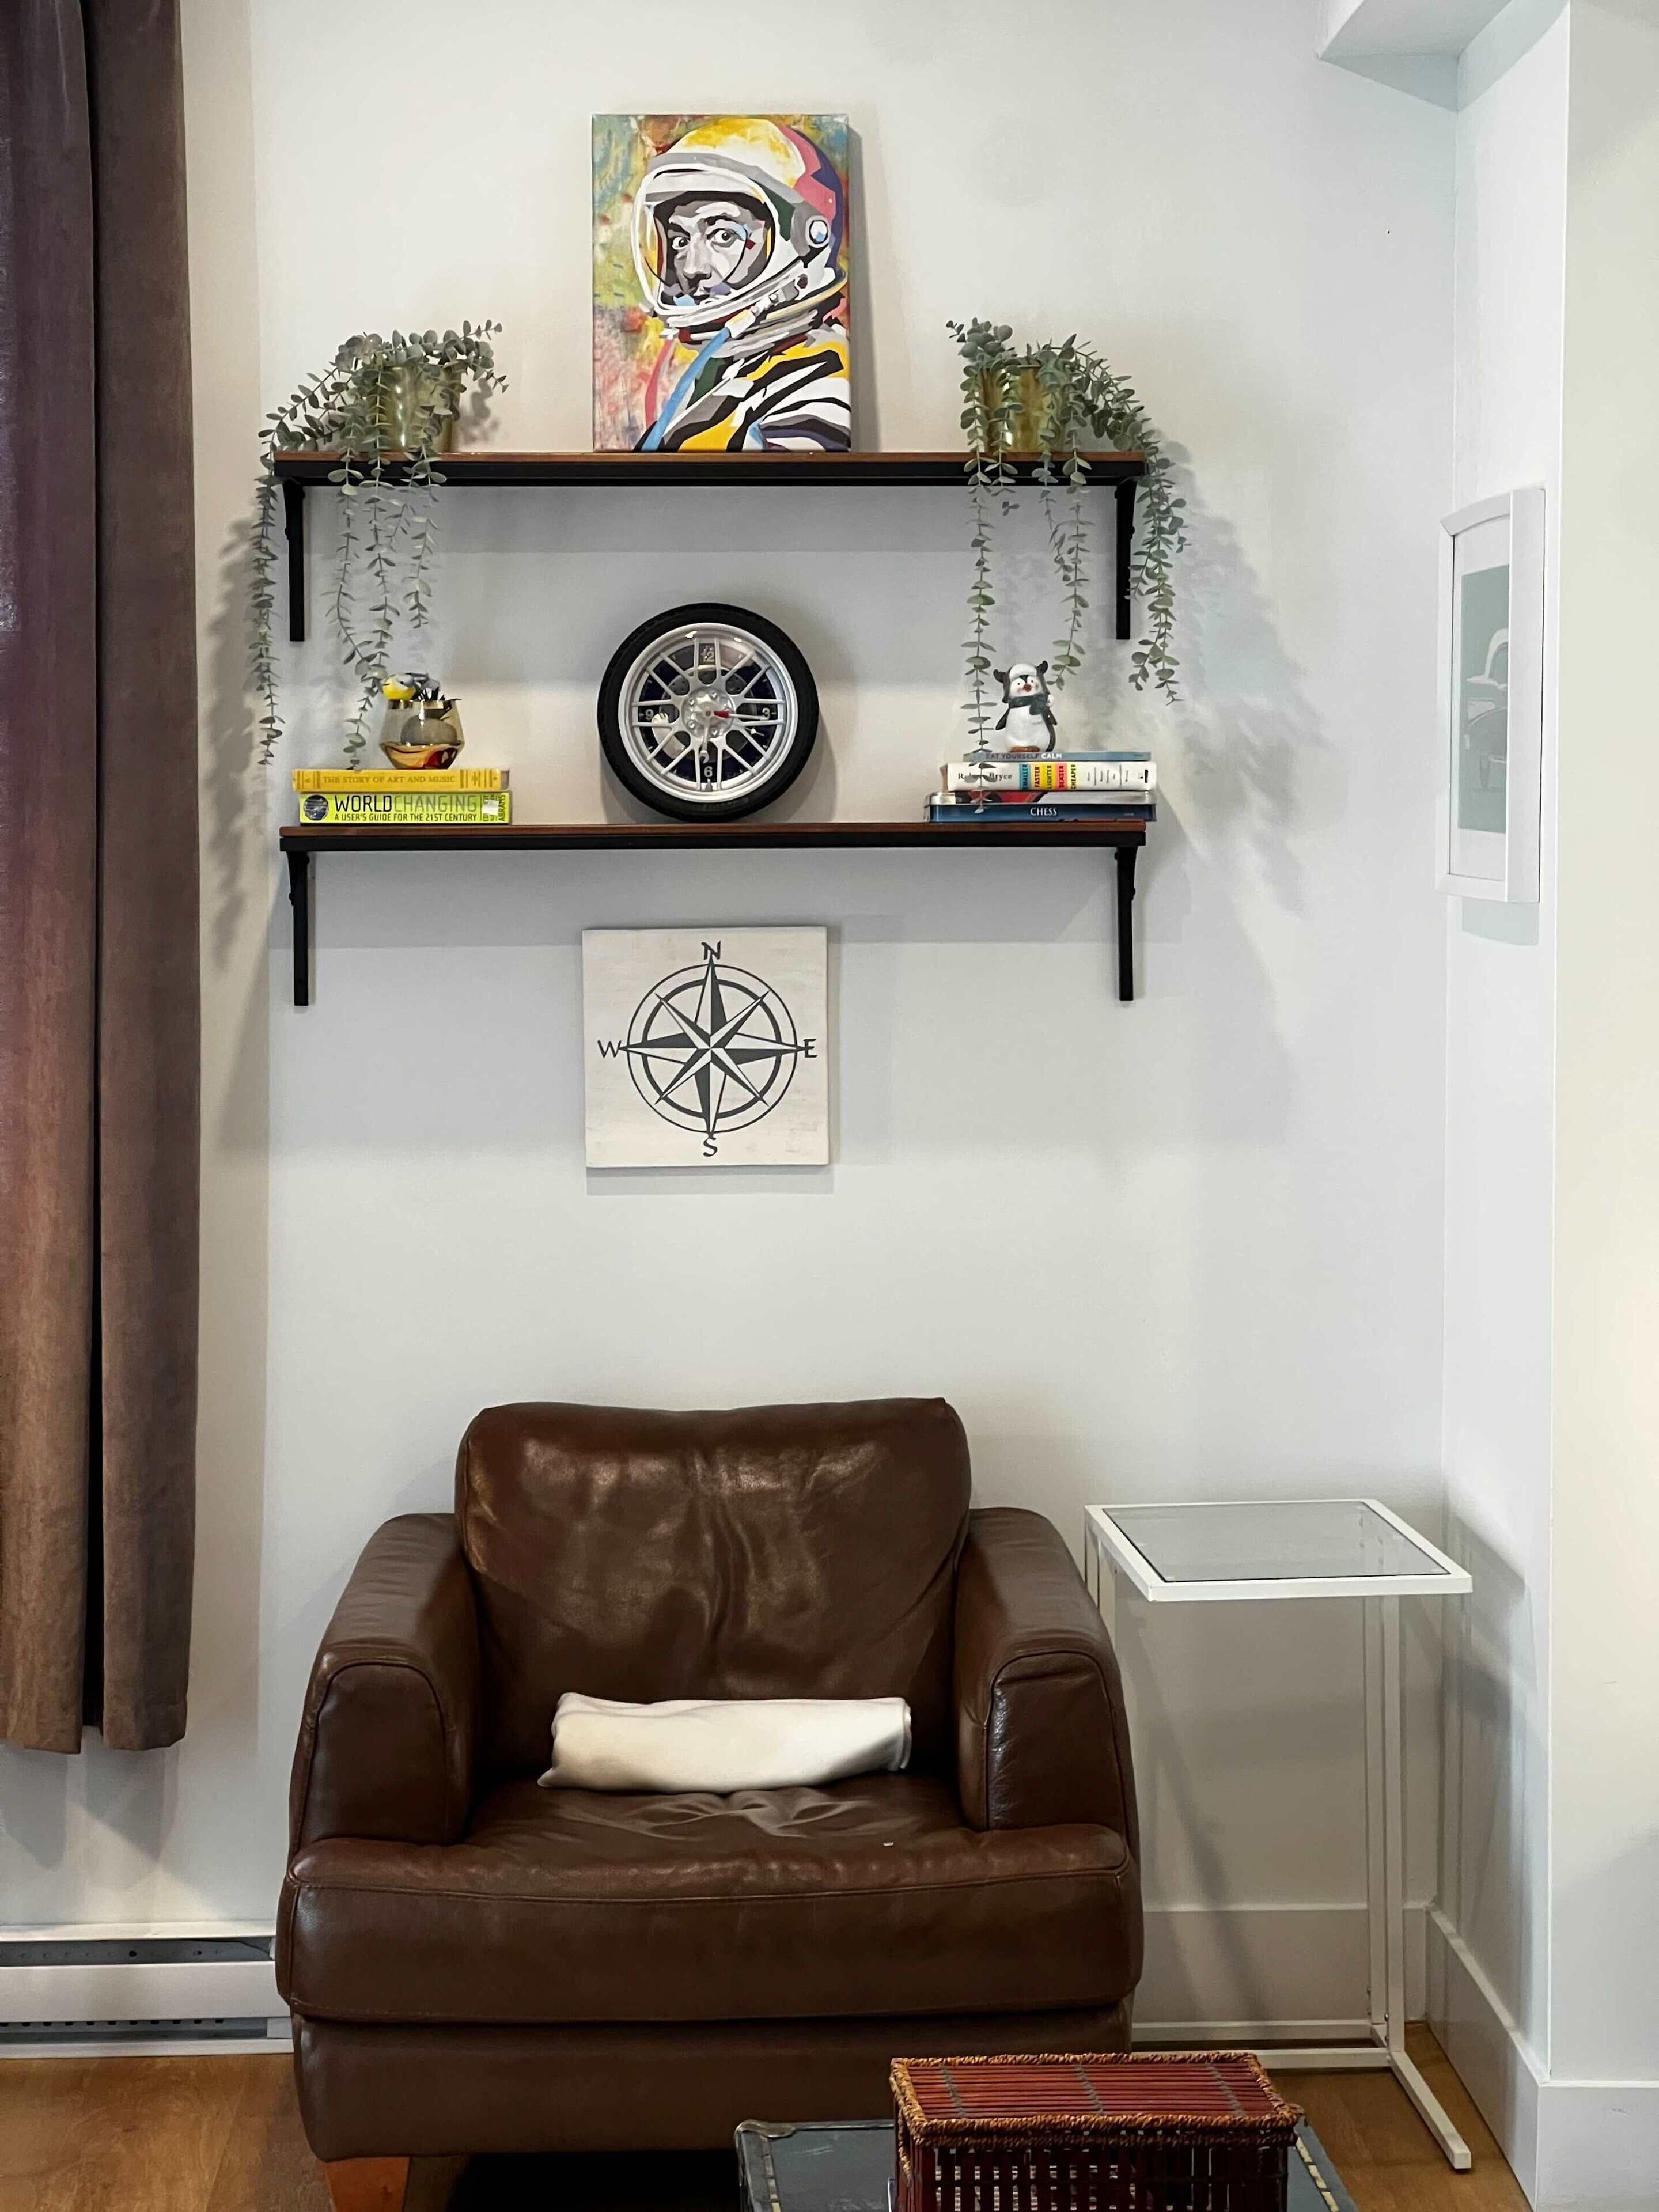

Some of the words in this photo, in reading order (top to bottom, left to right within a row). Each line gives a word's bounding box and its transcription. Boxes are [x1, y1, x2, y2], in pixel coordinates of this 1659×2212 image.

[645, 709, 653, 721] 9
[763, 707, 770, 720] 3
[704, 766, 713, 777] 6
[989, 772, 1013, 782] Bryce
[344, 775, 369, 783] STORY
[373, 775, 384, 783] OF
[387, 775, 405, 783] ART
[334, 794, 477, 812] WORLDCHANGING
[342, 813, 367, 821] USER'S
[369, 813, 391, 821] GUIDE
[394, 813, 408, 821] FOR
[411, 813, 423, 821] THE
[425, 813, 442, 821] 21ST
[445, 813, 478, 821] CENTURY
[1030, 807, 1058, 816] CHESS
[701, 941, 721, 960] N
[597, 1040, 622, 1058] W
[803, 1039, 818, 1058] E
[703, 1136, 718, 1157] S
